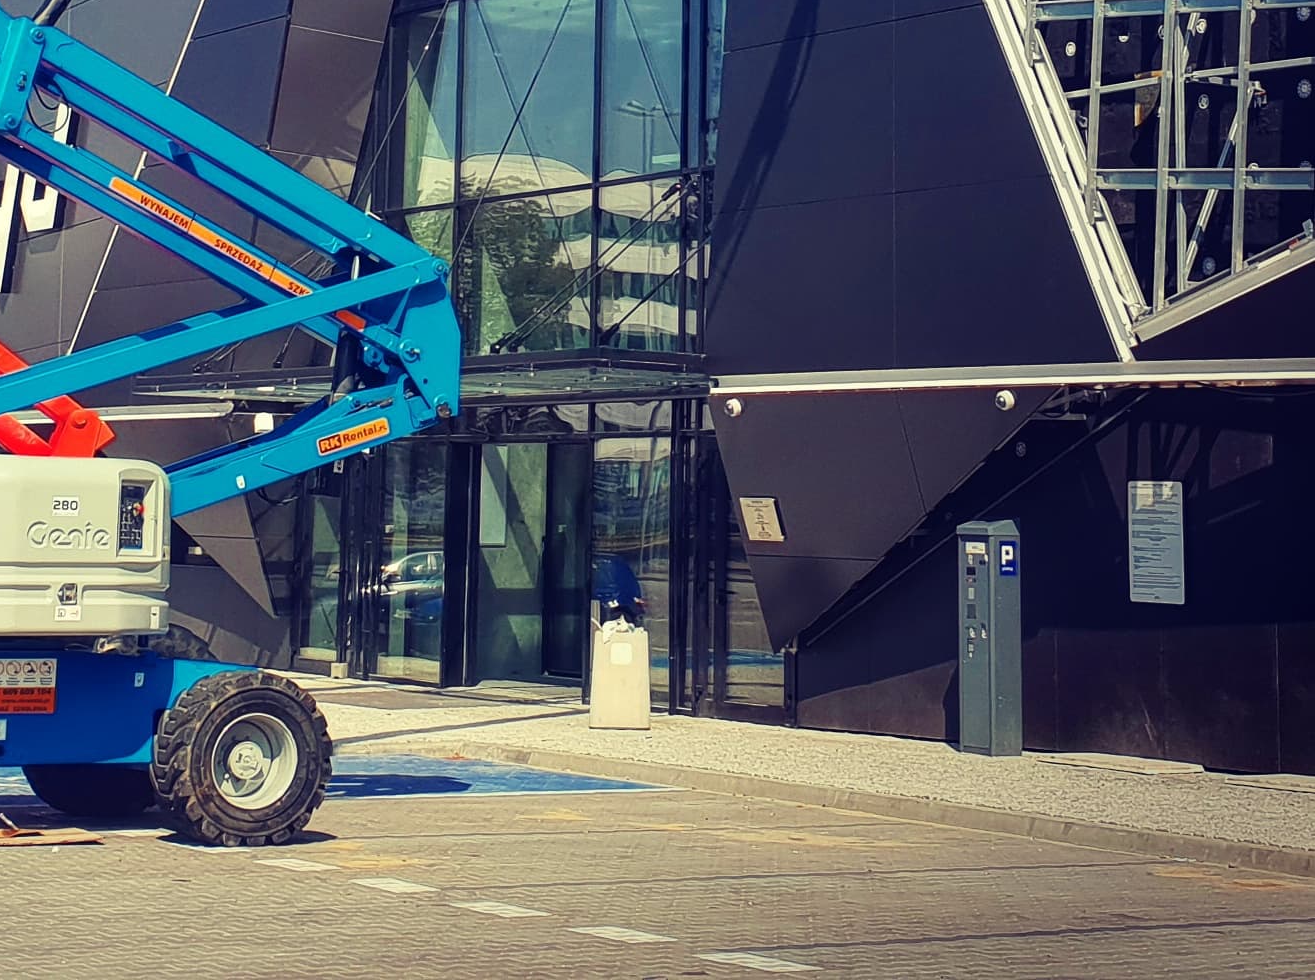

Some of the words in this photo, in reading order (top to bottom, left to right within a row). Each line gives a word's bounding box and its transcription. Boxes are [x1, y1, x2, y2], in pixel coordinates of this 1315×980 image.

[140, 195, 189, 229] WYNAJEM
[319, 435, 341, 453] RK
[53, 500, 79, 511] 280
[26, 521, 111, 550] Genie
[1001, 545, 1014, 566] P
